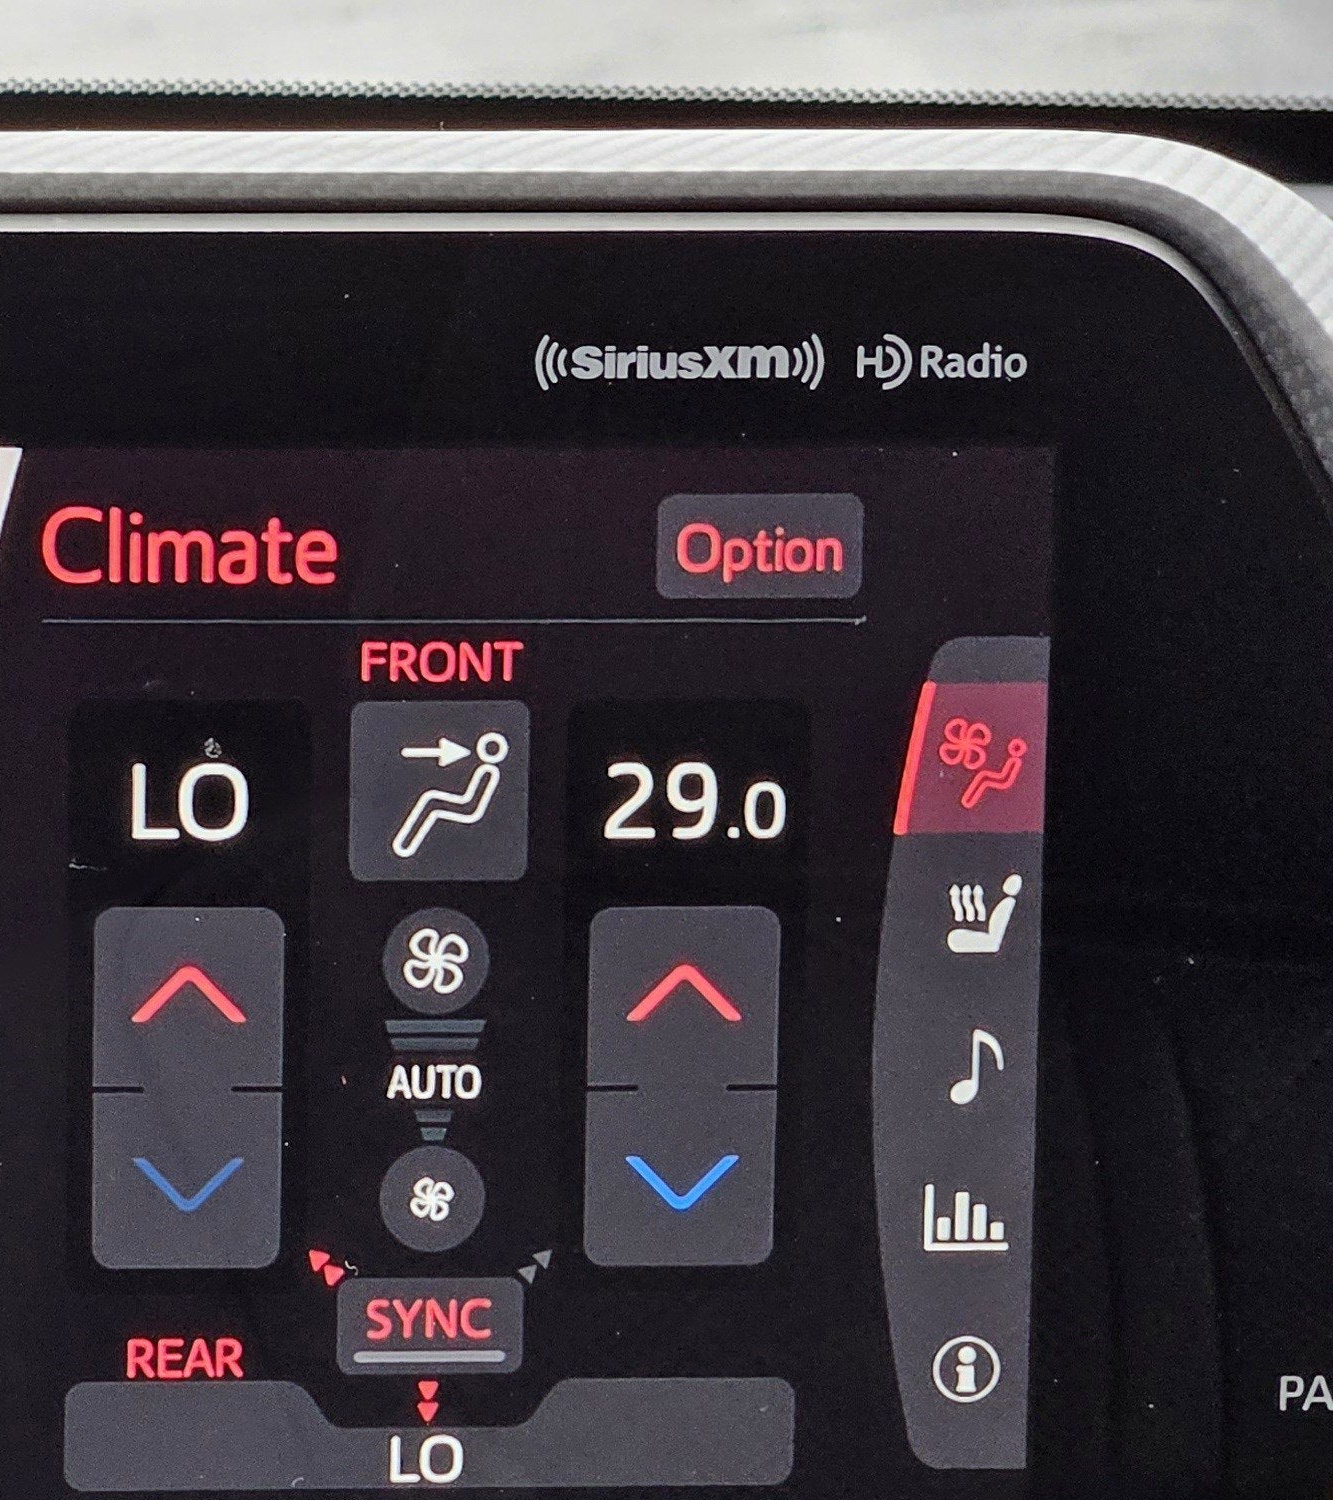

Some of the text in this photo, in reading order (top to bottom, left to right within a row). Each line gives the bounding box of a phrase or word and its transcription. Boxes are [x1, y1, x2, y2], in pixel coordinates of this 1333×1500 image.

[920, 341, 1028, 380] Radio
[41, 506, 339, 586] Climate
[676, 522, 844, 585] Option
[361, 640, 524, 684] FRONT
[131, 762, 250, 842] LO
[603, 761, 788, 841] 29.0
[386, 1064, 483, 1101] AUTO
[366, 1298, 493, 1340] SYNC
[126, 1337, 245, 1379] REAR
[389, 1434, 465, 1485] LO
